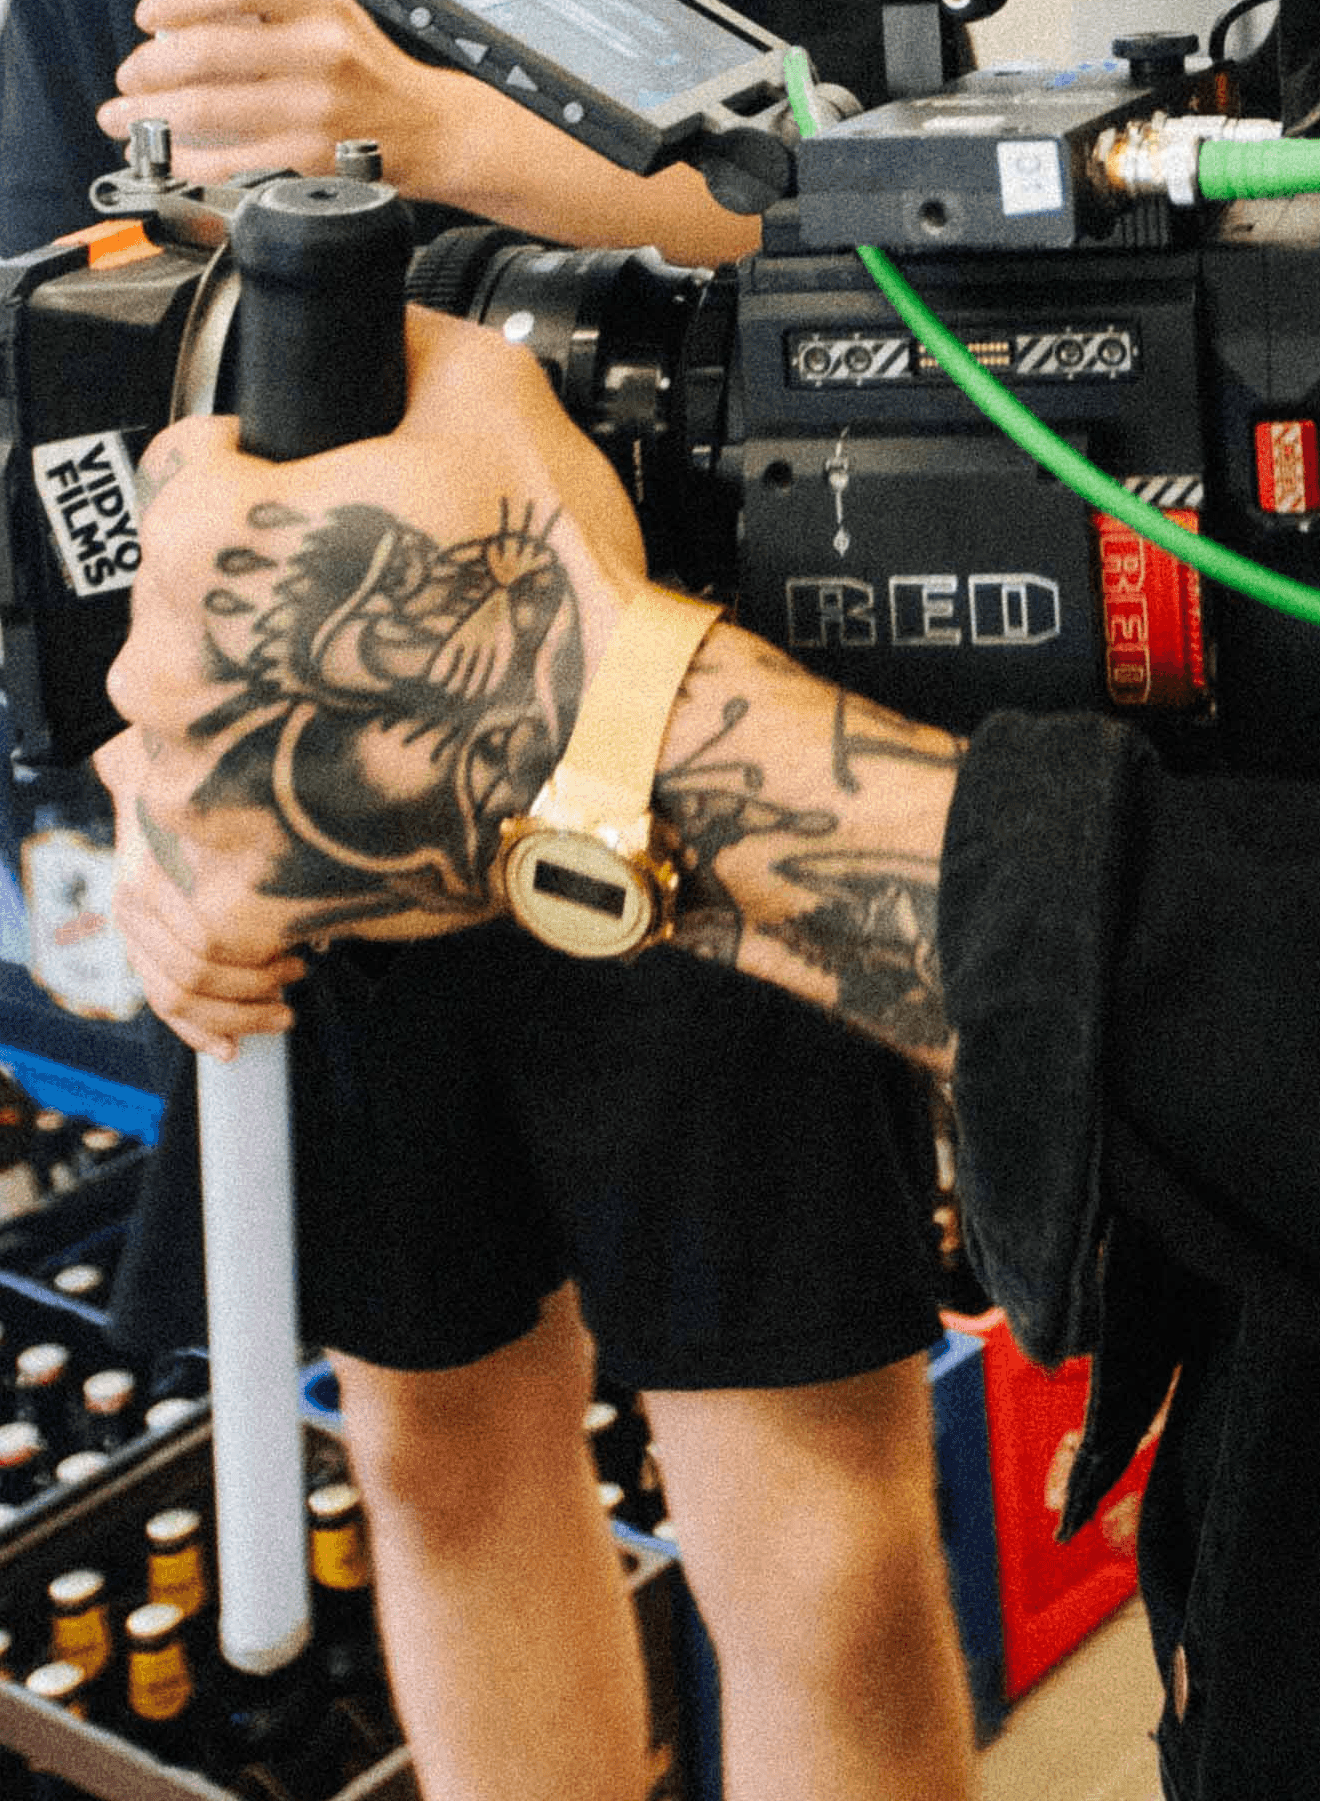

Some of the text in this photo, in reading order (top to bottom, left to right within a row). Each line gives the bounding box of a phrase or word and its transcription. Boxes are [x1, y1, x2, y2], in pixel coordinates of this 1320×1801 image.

[46, 459, 116, 586] FILMS
[78, 441, 143, 572] VIDYO
[786, 573, 1060, 647] RED
